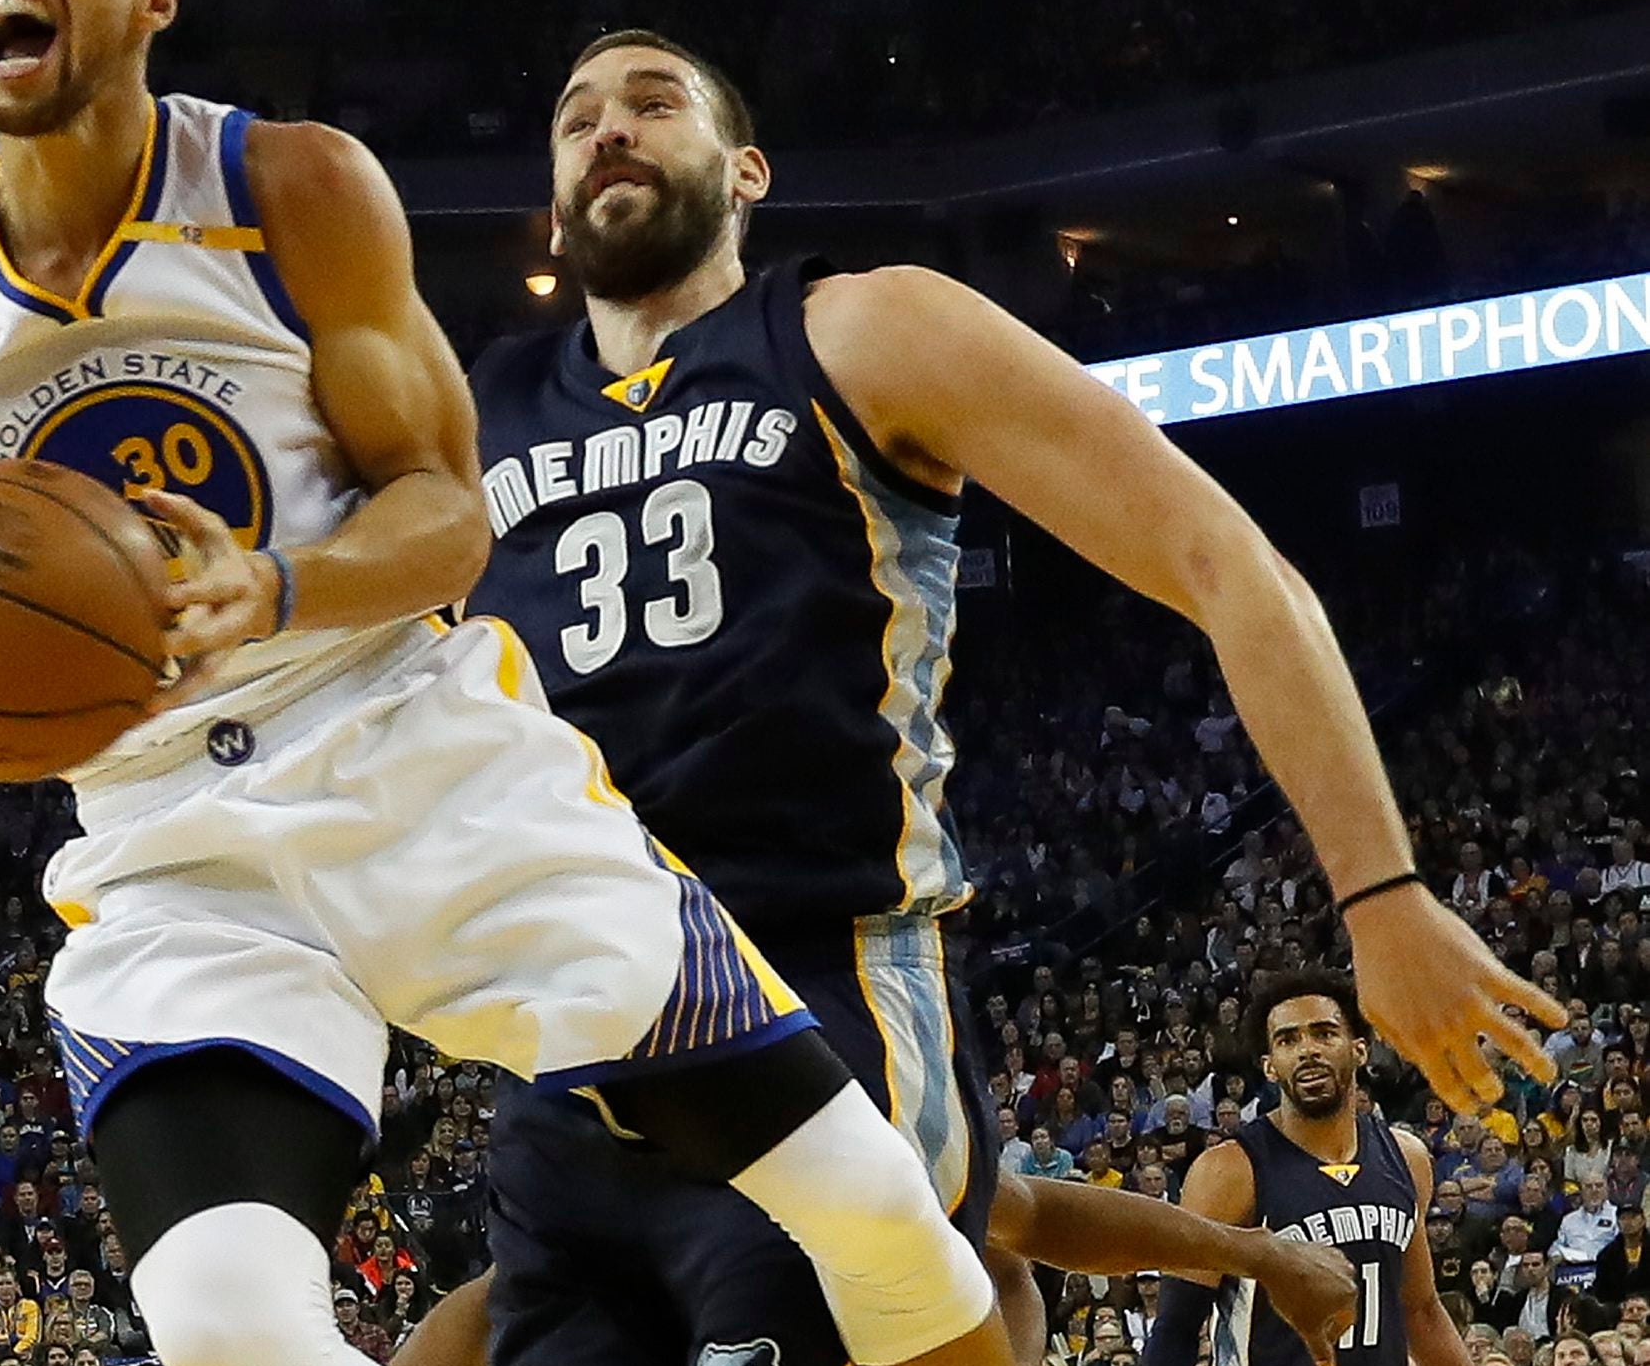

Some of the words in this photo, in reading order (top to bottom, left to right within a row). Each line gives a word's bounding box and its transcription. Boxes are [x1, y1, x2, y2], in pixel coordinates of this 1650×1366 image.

[124, 353, 242, 405] STATE
[111, 422, 214, 501] 30
[481, 399, 798, 539] MEMPHIS
[555, 479, 724, 675] 33
